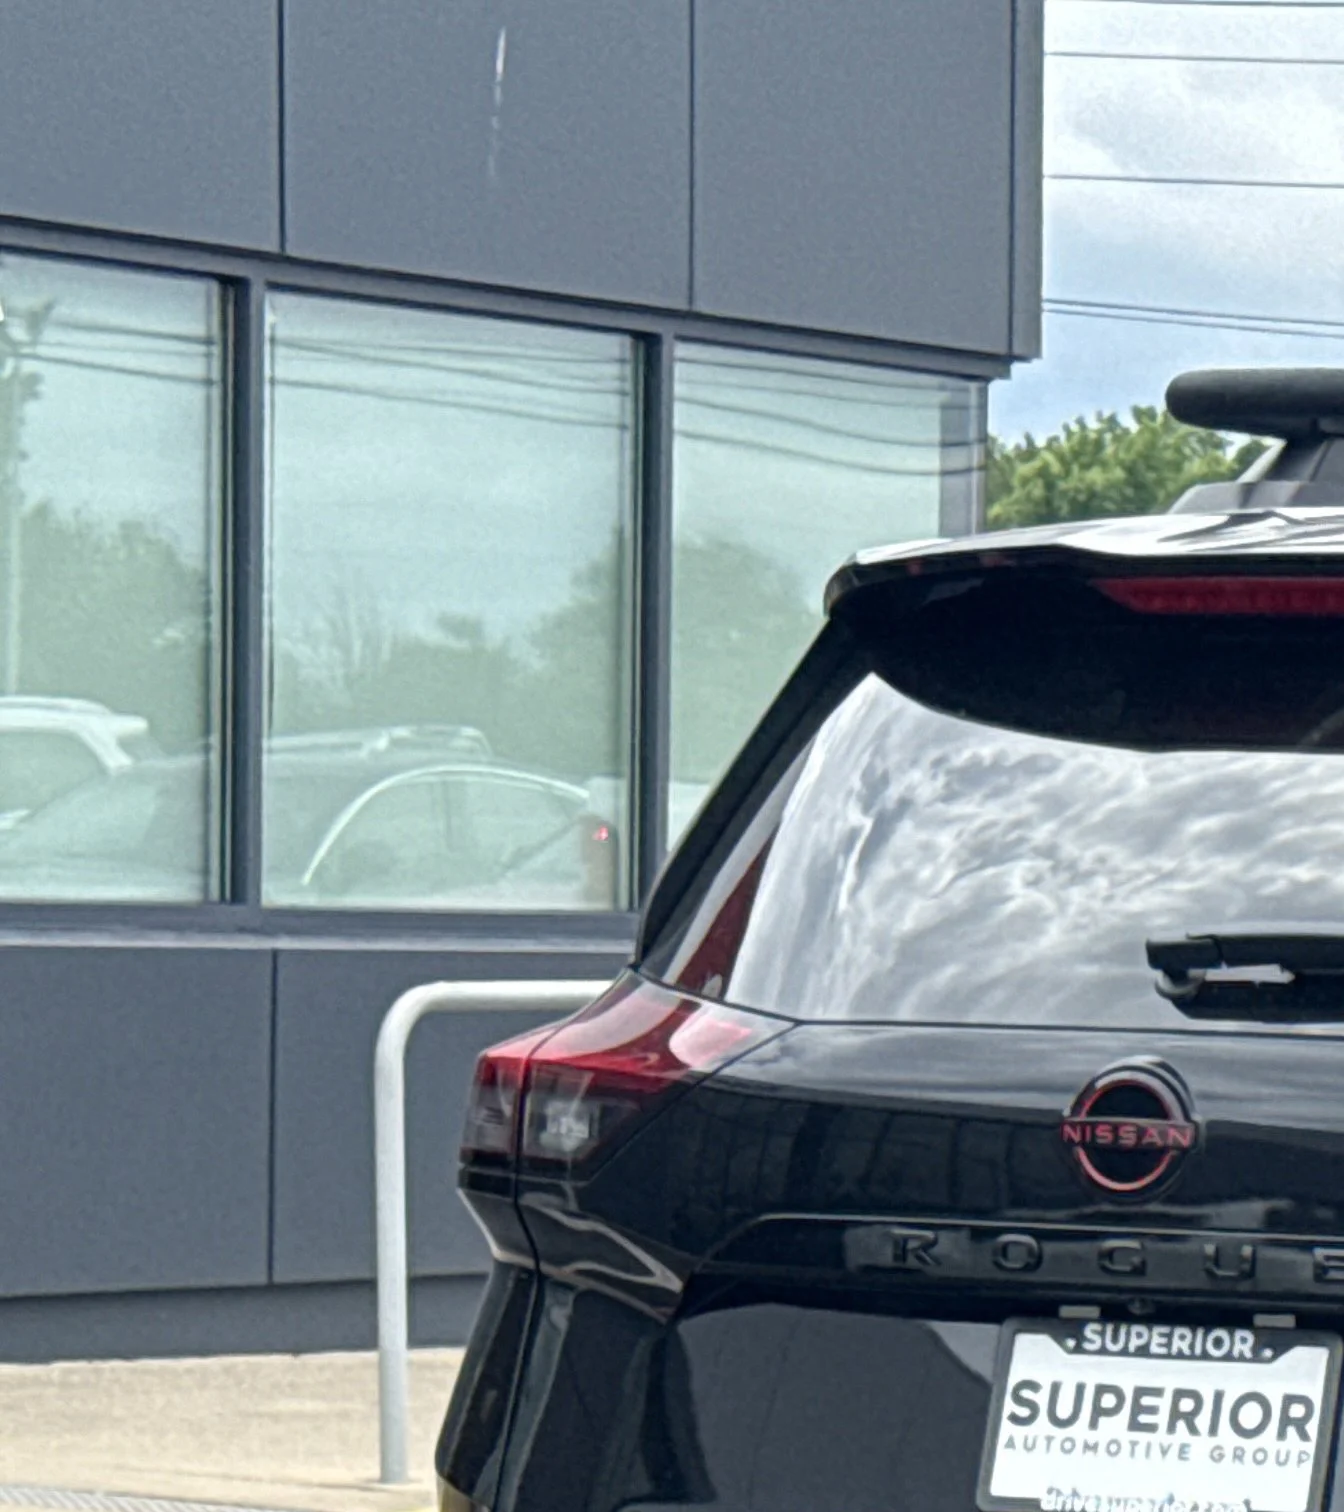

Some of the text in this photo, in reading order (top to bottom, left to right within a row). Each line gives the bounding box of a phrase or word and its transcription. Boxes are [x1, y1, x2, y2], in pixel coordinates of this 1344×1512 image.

[1061, 1121, 1196, 1149] NISSAN
[1081, 1322, 1256, 1359] SUPERIOR
[1006, 1379, 1316, 1442] SUPERIOR
[1003, 1433, 1312, 1468] AUTOMOTIVE GROUP
